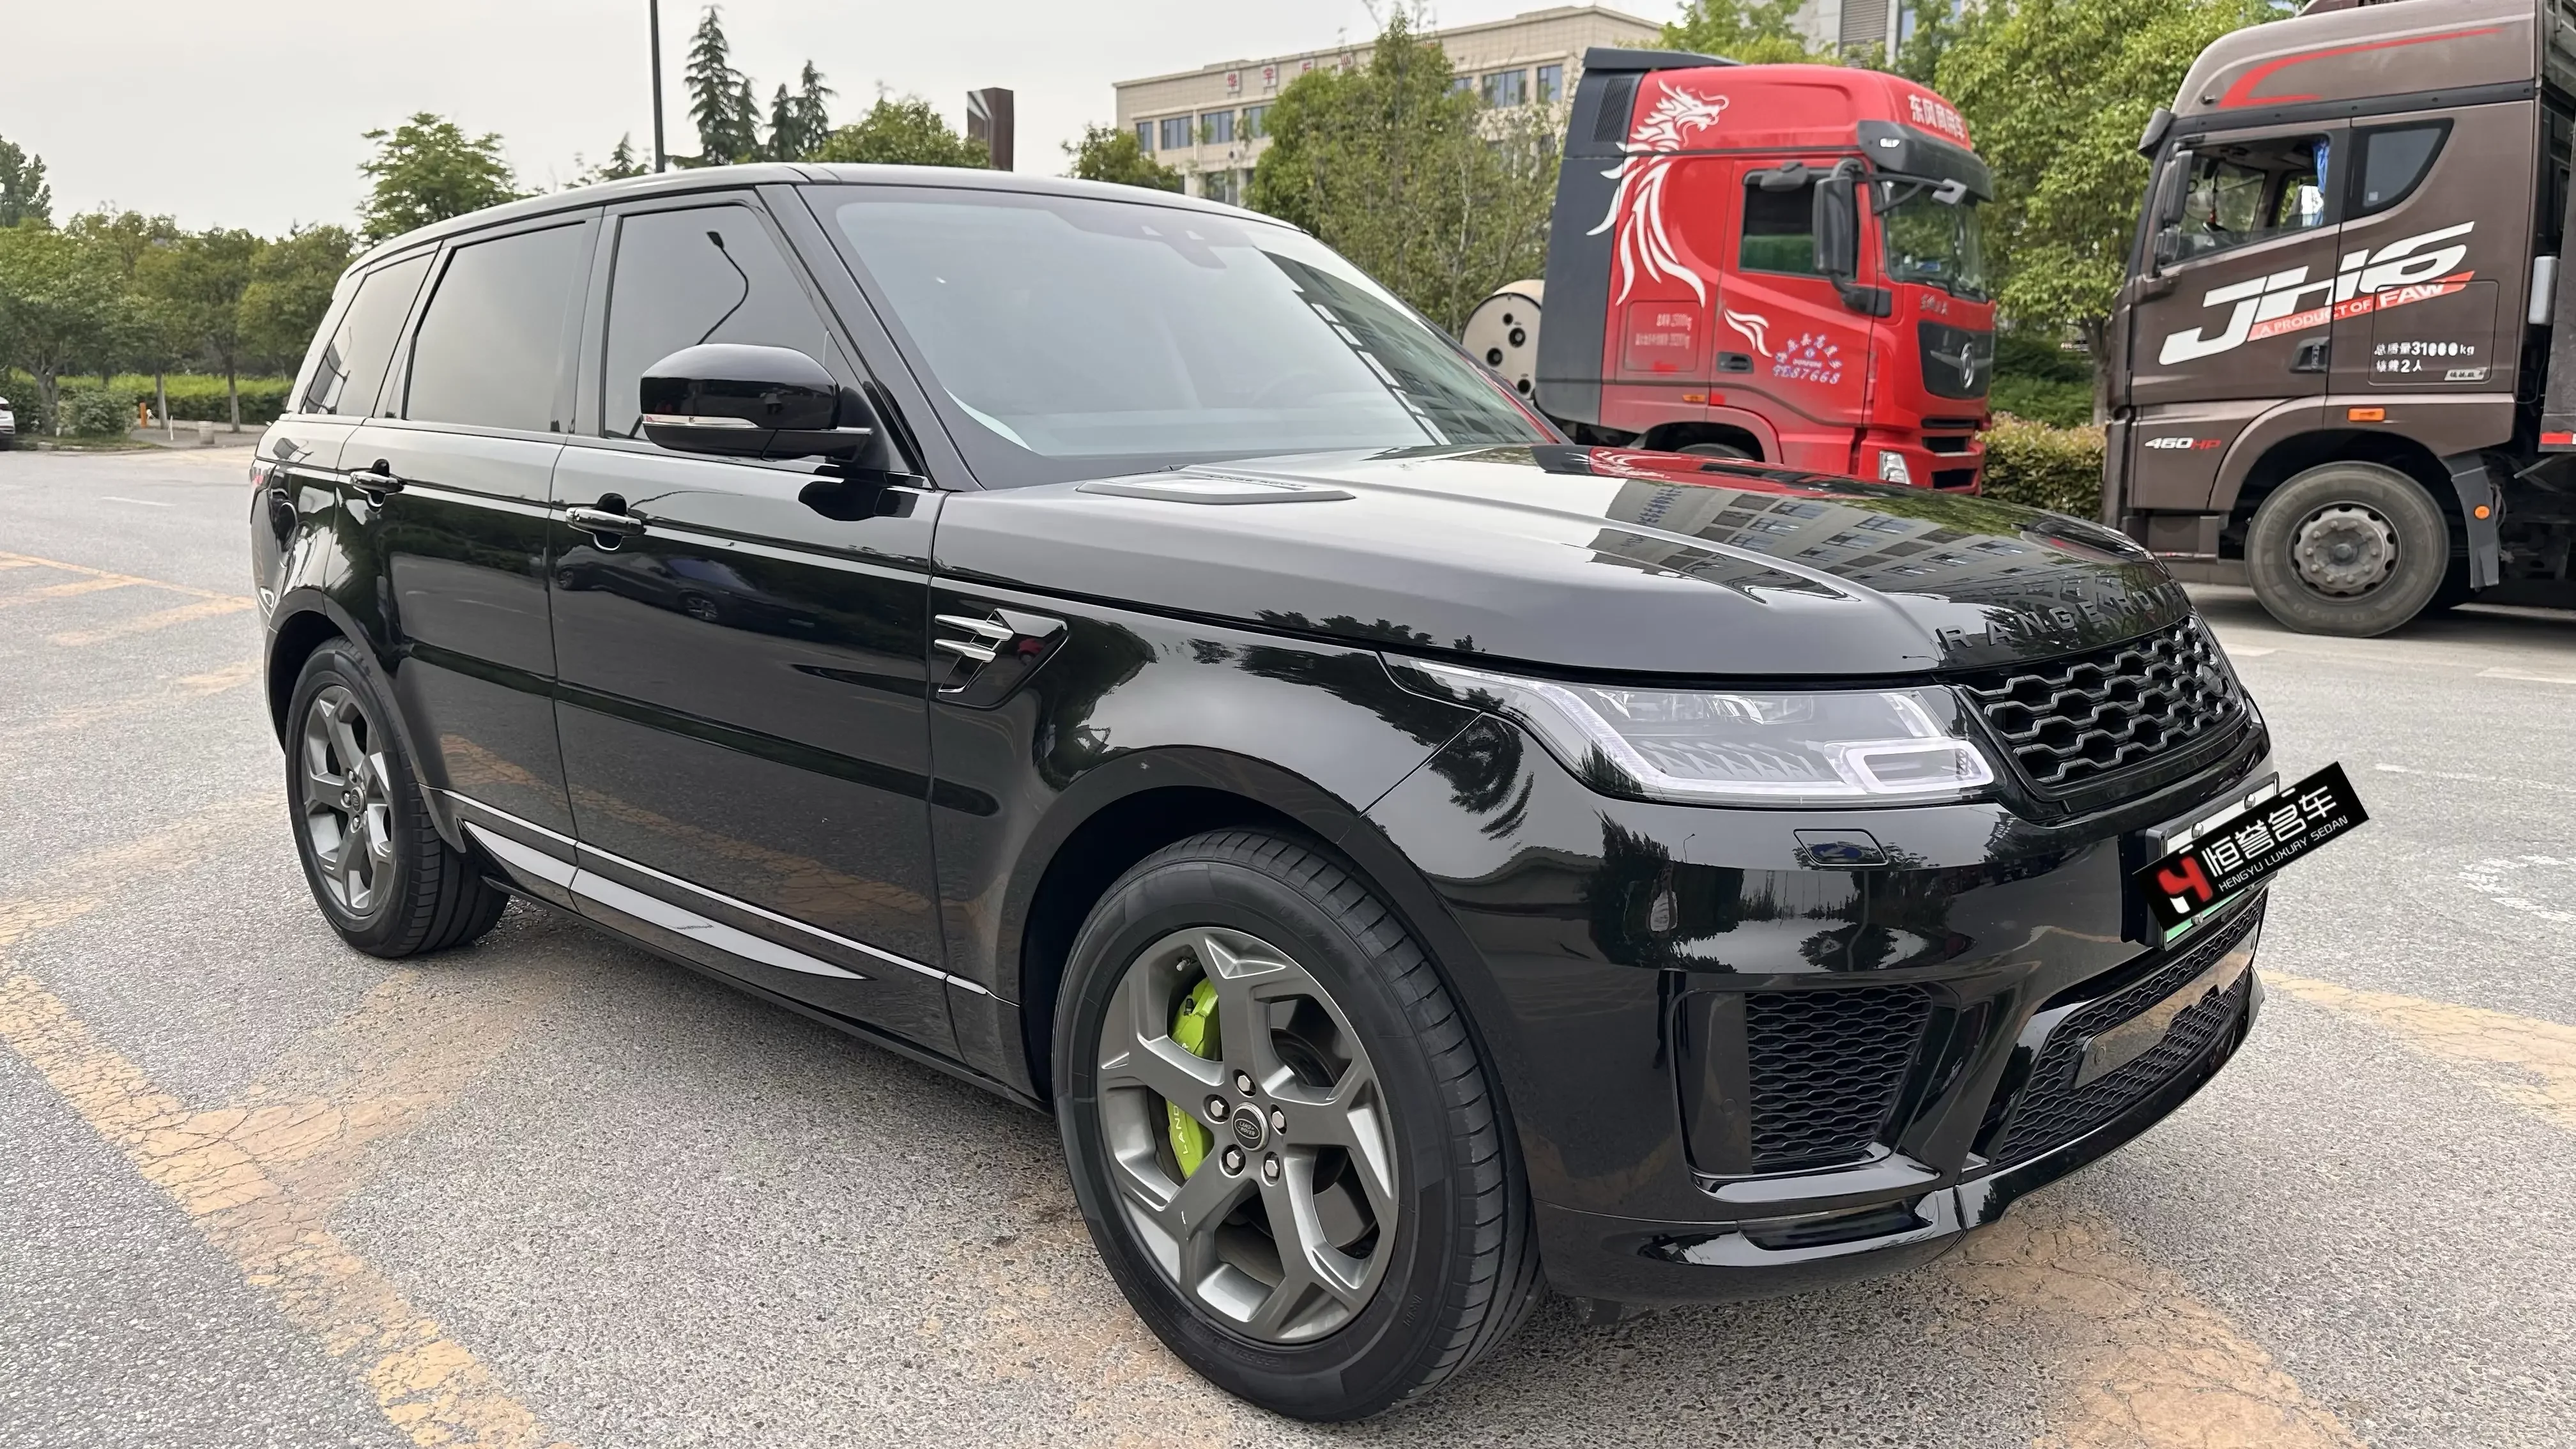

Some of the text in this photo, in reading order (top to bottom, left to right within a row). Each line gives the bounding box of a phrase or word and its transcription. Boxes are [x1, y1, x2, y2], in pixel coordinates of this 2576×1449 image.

[2159, 221, 2476, 365] JH6
[2274, 304, 2348, 331] PRODUCT
[2350, 298, 2372, 312] OF
[2379, 283, 2444, 308] FAW
[1935, 601, 2103, 651] RANGE
[1173, 1105, 1188, 1155] LAND
